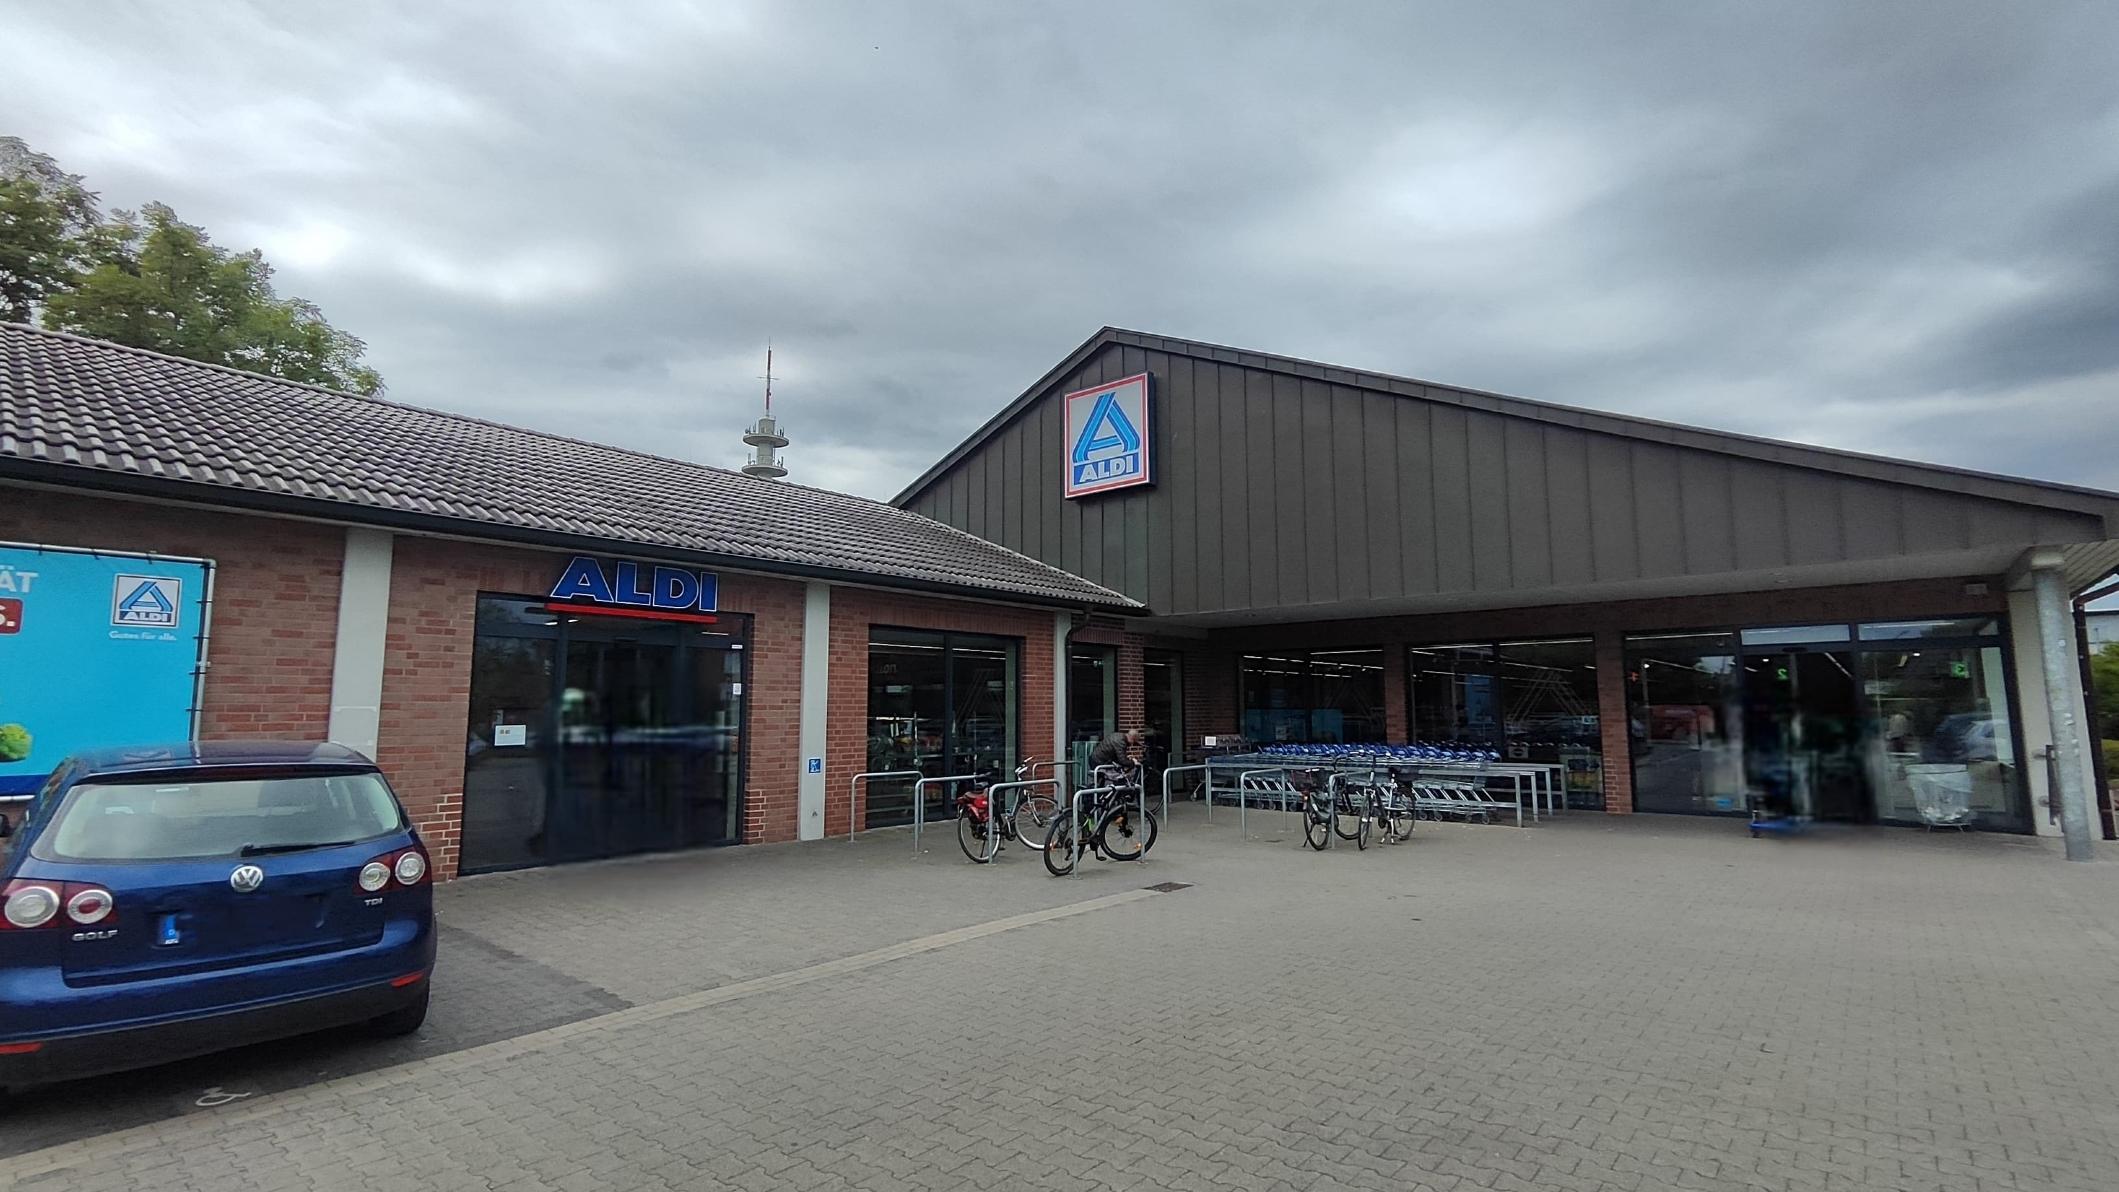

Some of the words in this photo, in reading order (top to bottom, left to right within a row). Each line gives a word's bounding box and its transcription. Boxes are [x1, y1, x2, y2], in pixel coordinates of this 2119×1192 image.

[1079, 455, 1134, 482] ALDI
[550, 556, 718, 612] ALDI
[123, 611, 168, 622] ALDI
[364, 897, 383, 906] TDI
[72, 929, 118, 941] GOLF
